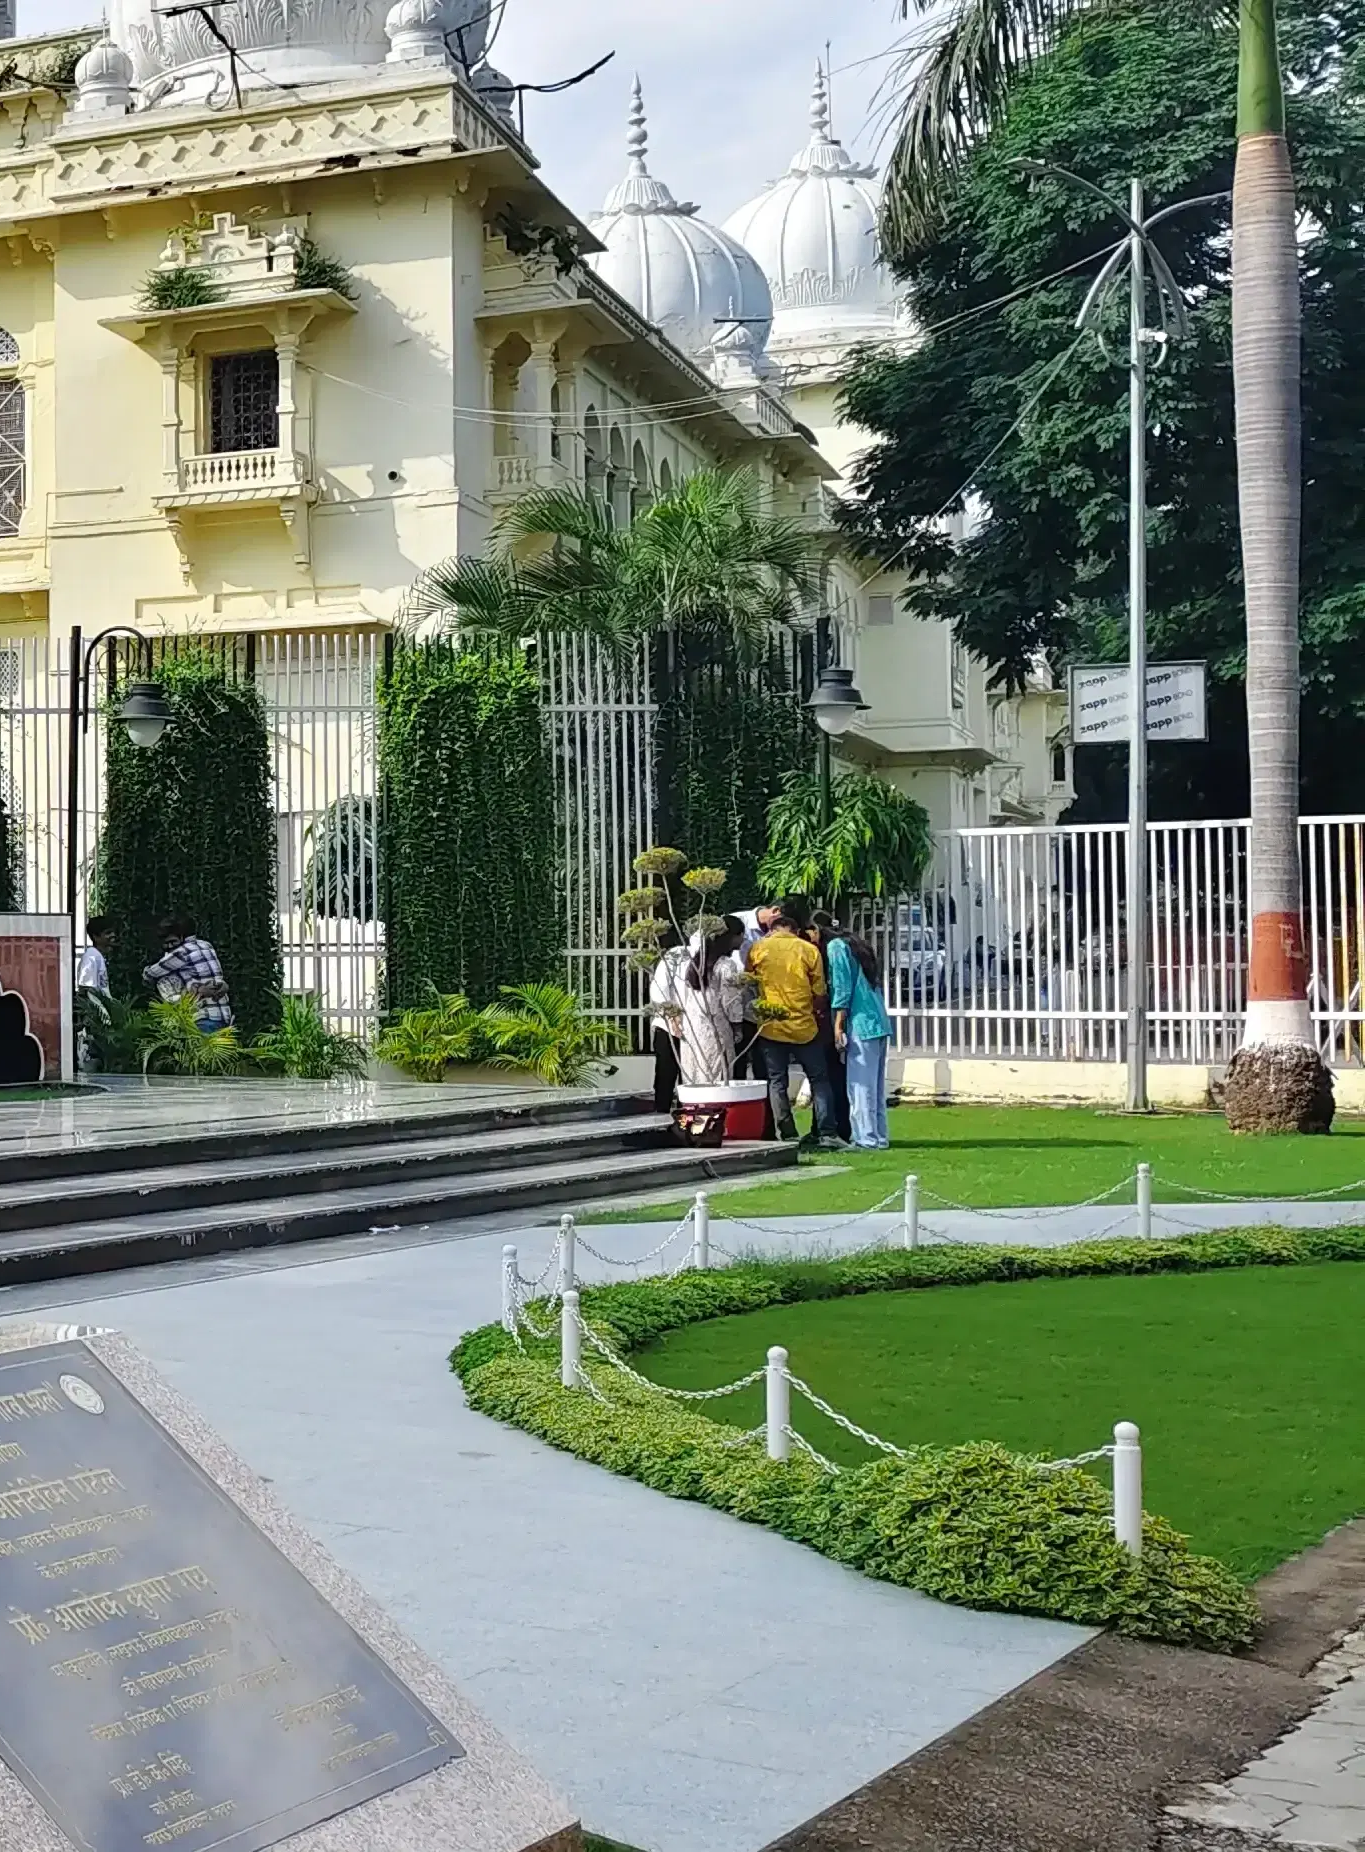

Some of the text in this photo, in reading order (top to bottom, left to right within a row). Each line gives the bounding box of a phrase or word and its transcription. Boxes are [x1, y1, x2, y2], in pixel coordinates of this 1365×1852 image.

[1080, 720, 1109, 734] zapp
[67, 1463, 124, 1494] पटेल
[45, 1589, 126, 1630] आलोक
[116, 1575, 171, 1619] कुमार
